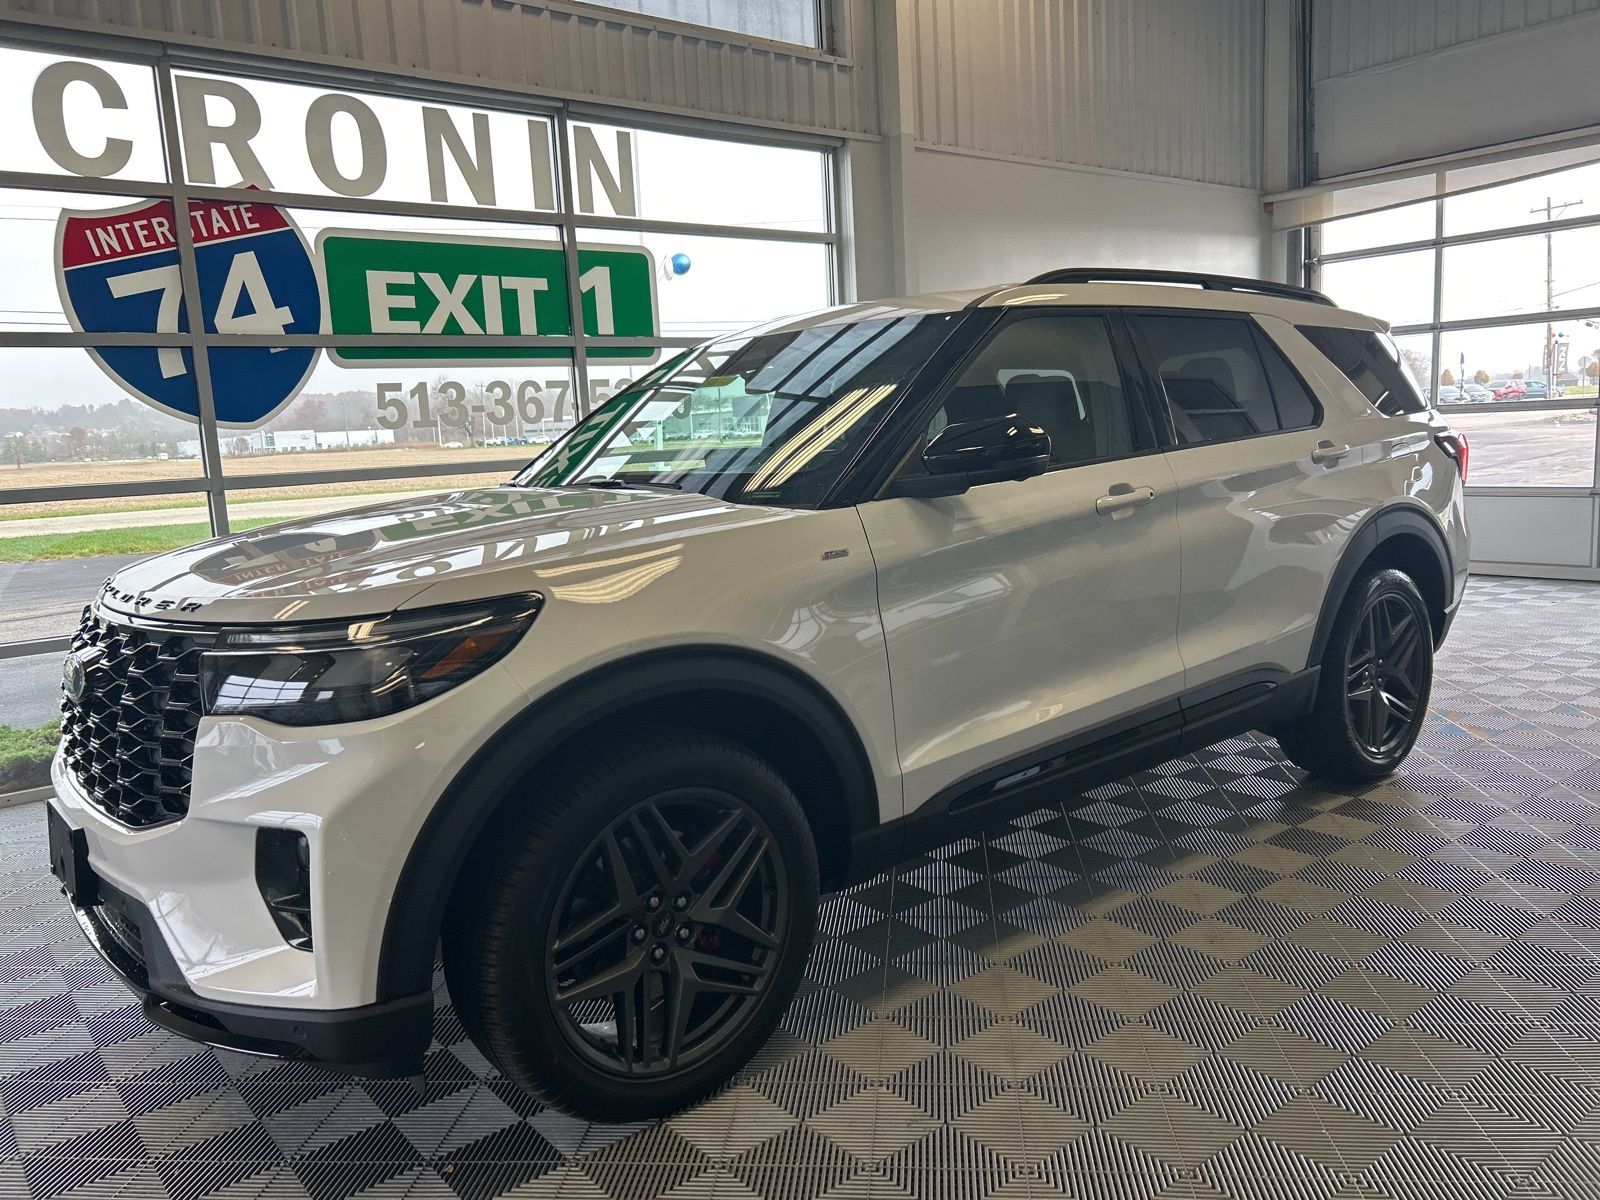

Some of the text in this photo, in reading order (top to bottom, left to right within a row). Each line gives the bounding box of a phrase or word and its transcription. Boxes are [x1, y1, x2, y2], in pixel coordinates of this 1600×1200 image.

[32, 61, 637, 217] CRONIN
[85, 203, 260, 257] INTERTATE
[106, 251, 294, 378] 74
[365, 266, 614, 335] EXIT 1
